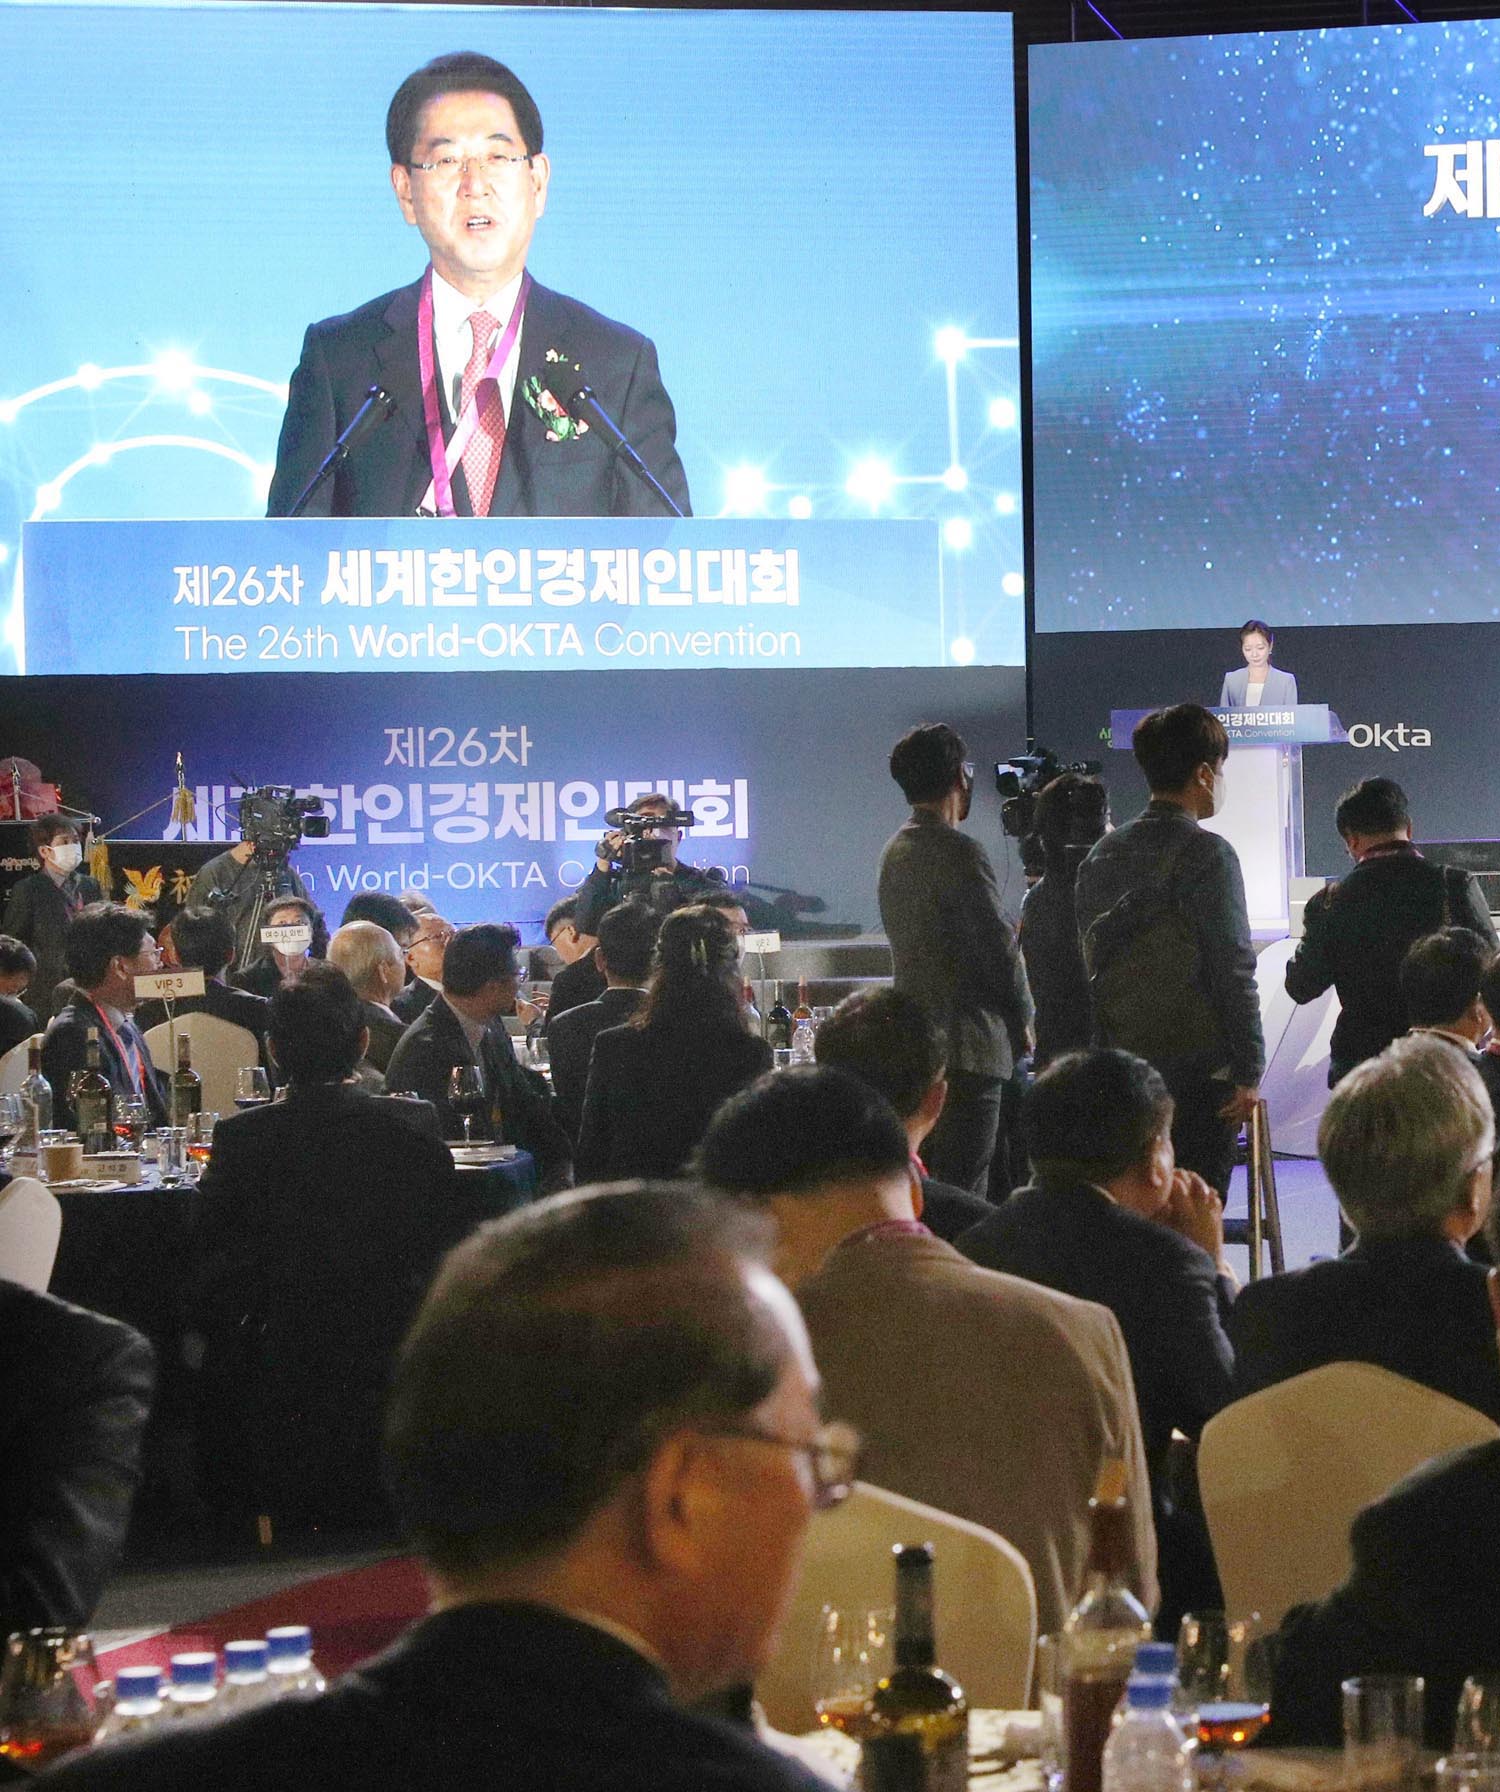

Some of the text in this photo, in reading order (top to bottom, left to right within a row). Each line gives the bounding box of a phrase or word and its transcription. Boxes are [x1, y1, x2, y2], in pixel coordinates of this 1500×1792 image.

[174, 548, 800, 607] 제26차 세계한인경제인대회
[174, 620, 801, 661] The 26th World-OKTA Convention
[1214, 712, 1295, 727] 인경제인대회
[1244, 728, 1295, 738] Convention
[384, 724, 534, 768] 제26차
[162, 779, 750, 845] 세한인경제인회
[326, 861, 542, 891] World-OKTA
[155, 977, 183, 990] VIP 3
